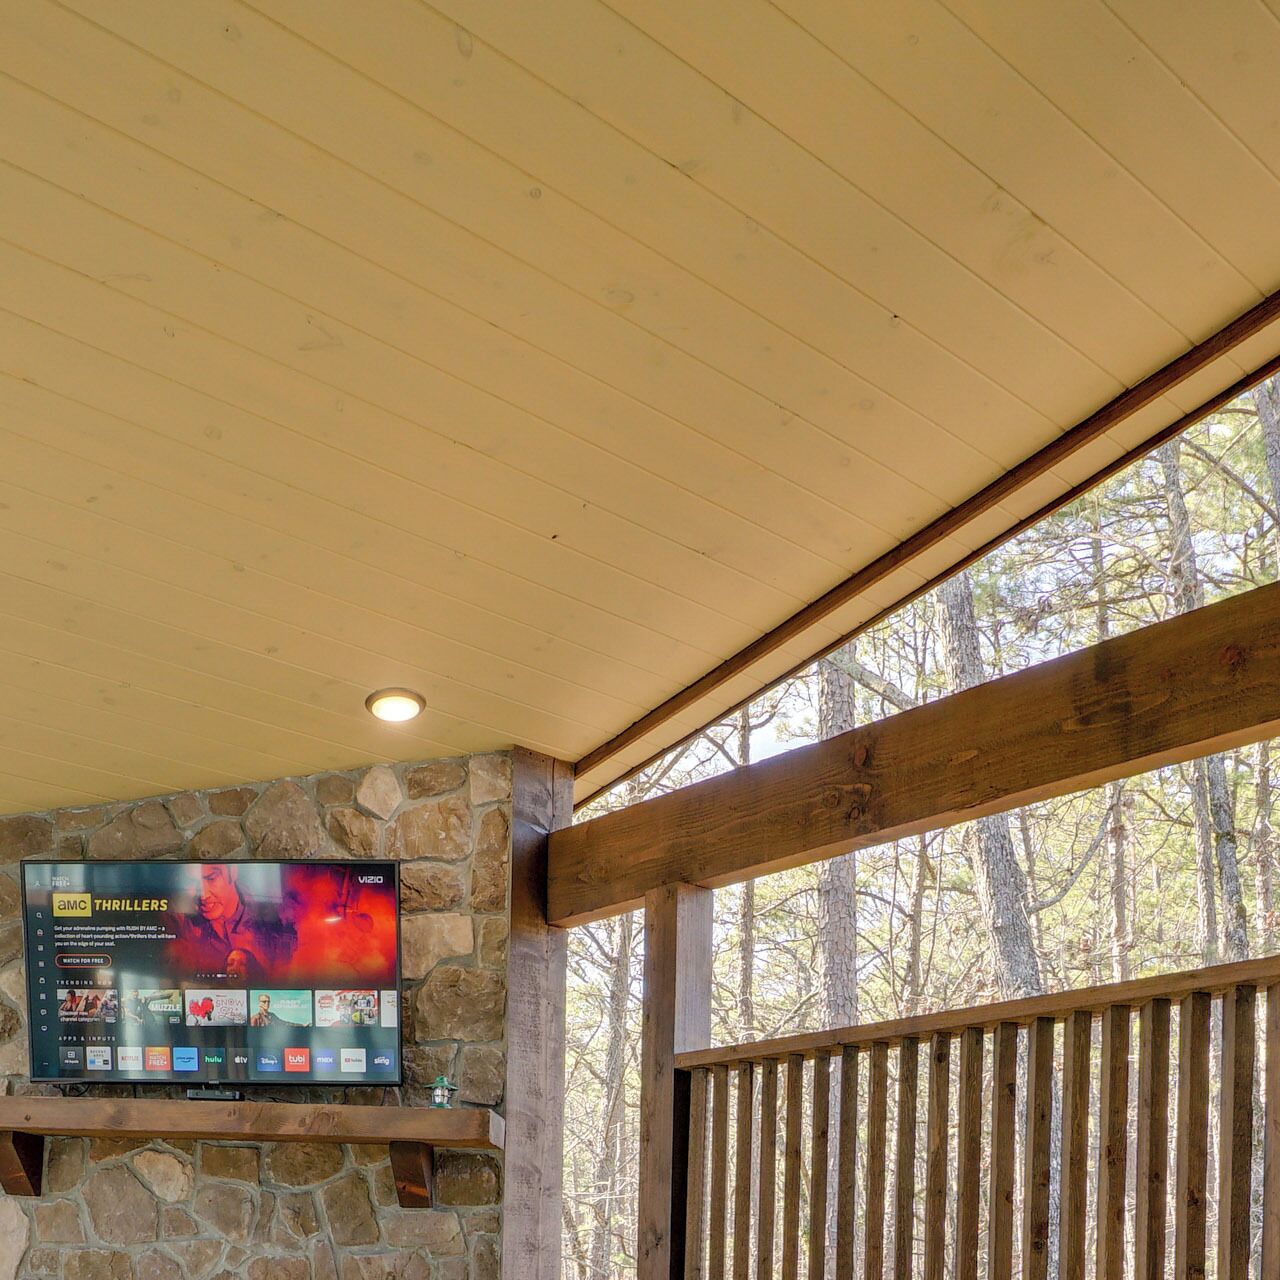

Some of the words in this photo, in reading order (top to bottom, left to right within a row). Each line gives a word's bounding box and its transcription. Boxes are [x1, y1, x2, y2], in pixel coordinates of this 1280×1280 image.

[358, 875, 384, 884] VIZIO
[94, 899, 169, 911] THRILLERS
[216, 999, 244, 1008] SNOW
[288, 1055, 305, 1063] tubi
